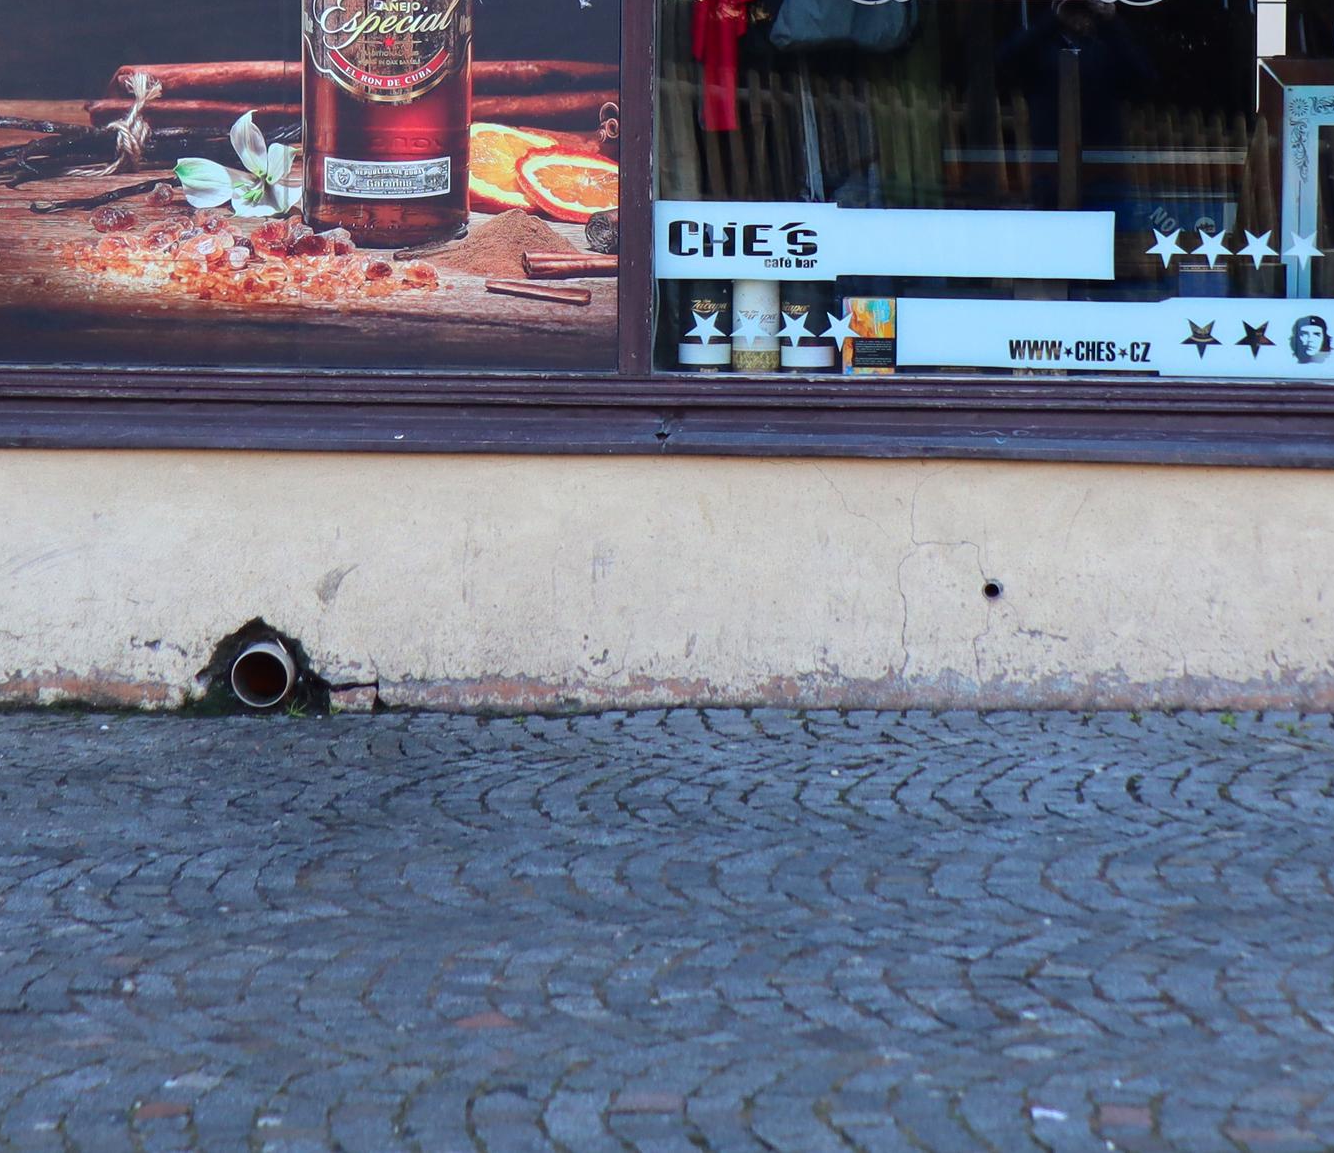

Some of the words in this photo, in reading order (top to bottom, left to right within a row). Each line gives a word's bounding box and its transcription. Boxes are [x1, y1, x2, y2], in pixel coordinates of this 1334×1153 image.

[381, 0, 420, 12] AÑEJO
[345, 67, 356, 78] EL
[360, 75, 382, 86] RON
[387, 79, 401, 87] DE
[404, 67, 432, 85] CUBA
[795, 257, 817, 268] bar
